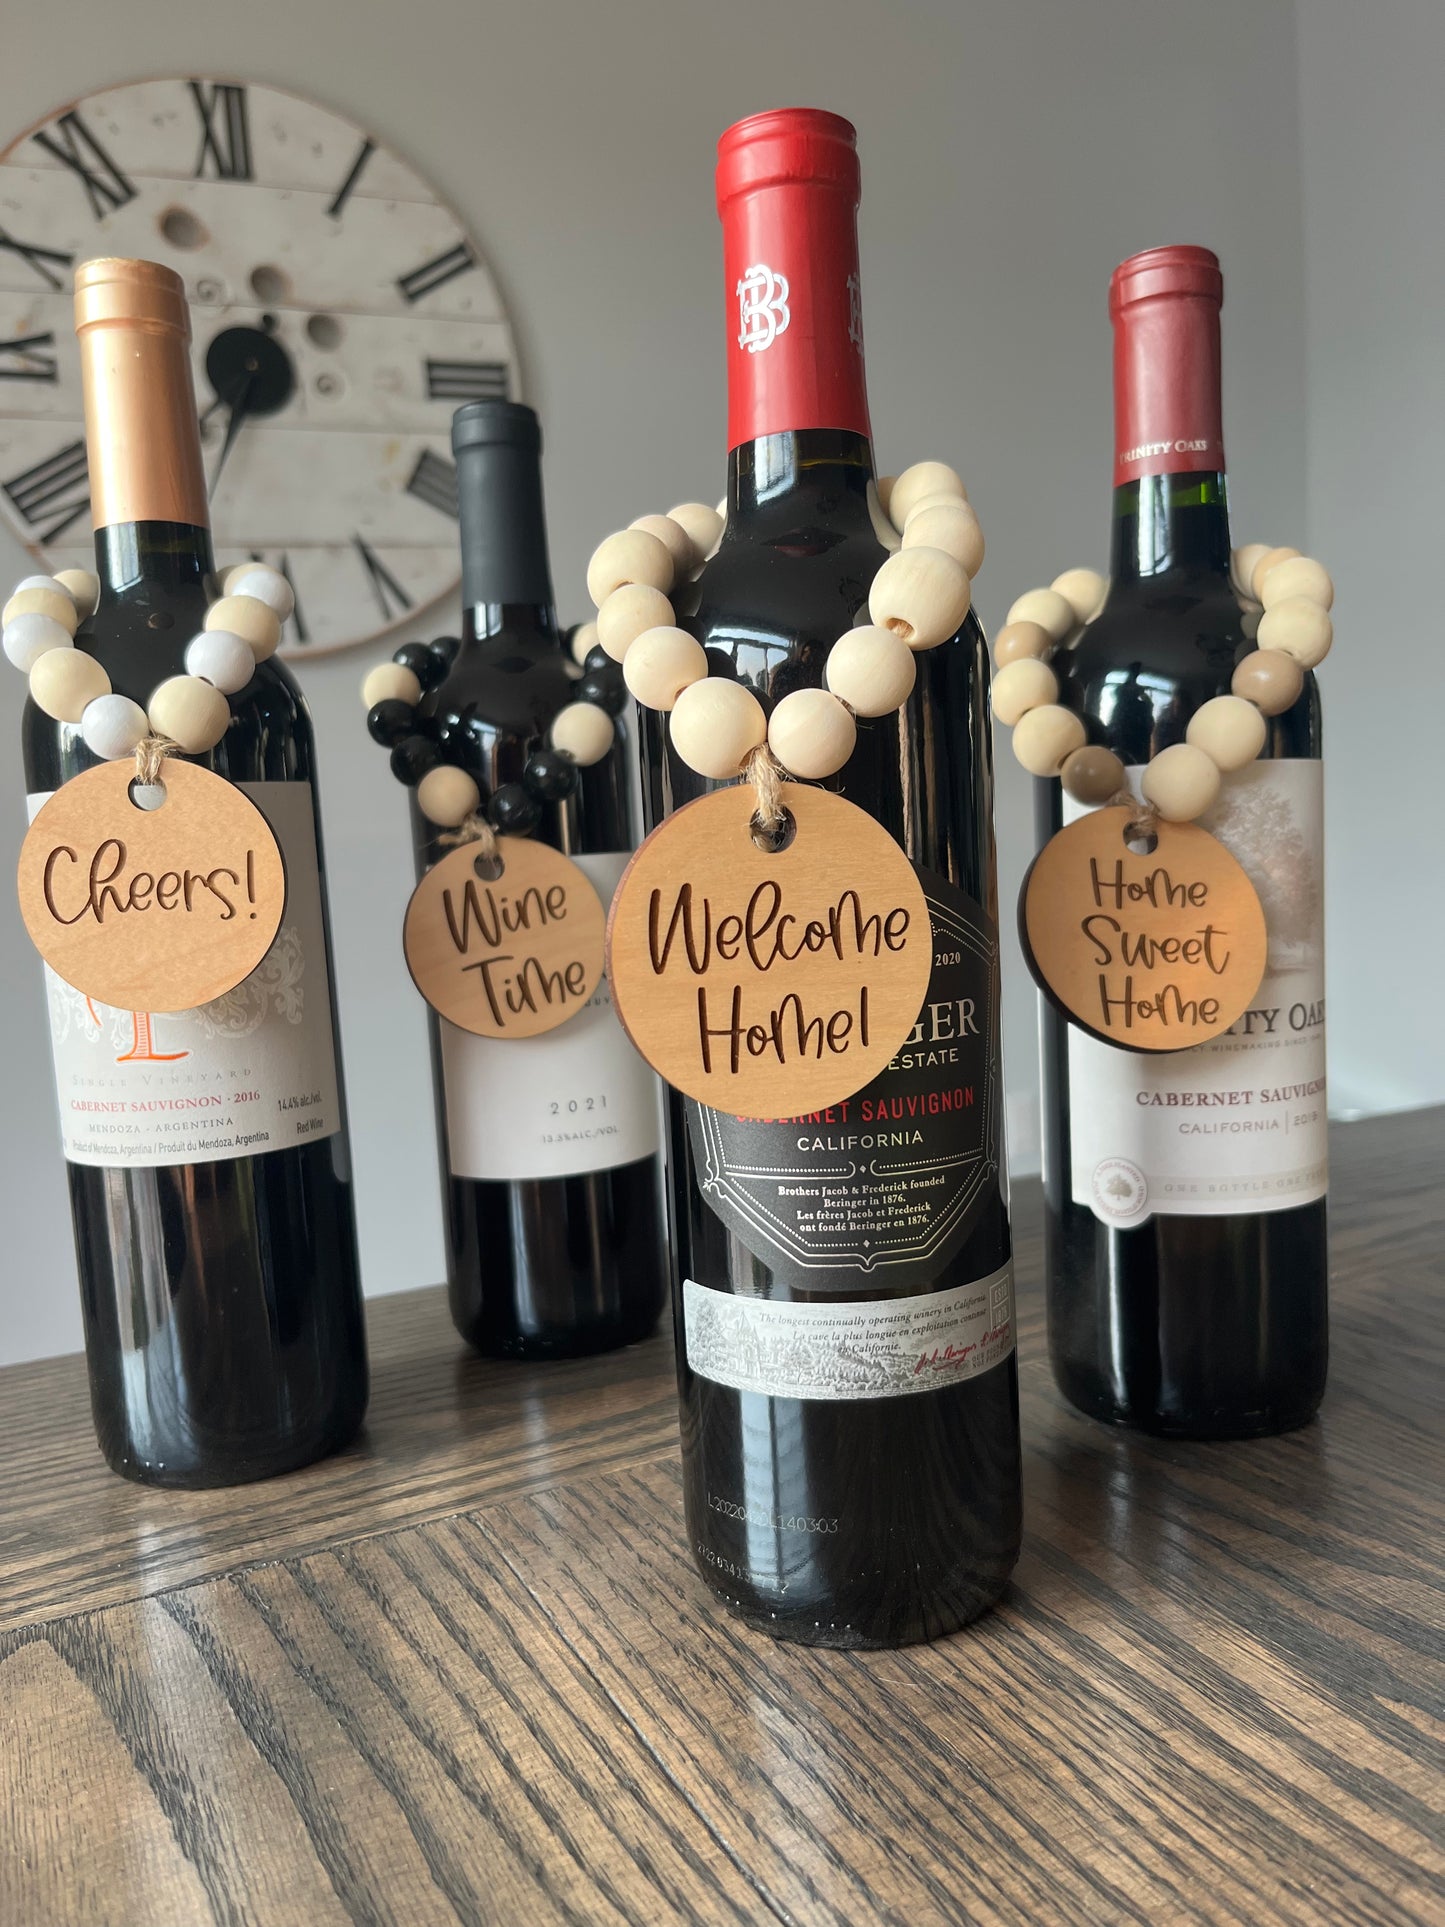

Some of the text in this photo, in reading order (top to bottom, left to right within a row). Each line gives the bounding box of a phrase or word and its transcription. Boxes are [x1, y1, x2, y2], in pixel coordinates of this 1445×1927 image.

[187, 79, 255, 181] XII
[43, 838, 257, 925] Cheers!
[1090, 857, 1208, 910] Home
[442, 879, 567, 954] Wine
[648, 880, 910, 975] Welcome
[1081, 914, 1230, 975] Sweet
[935, 951, 961, 967] 2020
[461, 955, 586, 1027] Time
[1099, 974, 1220, 1027] Home
[887, 1047, 959, 1070] ESTATE
[71, 1090, 260, 1113] CABERNET SAUVIGNON 2016
[550, 1095, 607, 1115] 2021
[861, 1086, 974, 1122] SAUVIGNON
[1135, 1091, 1254, 1107] CABERNET
[89, 1124, 141, 1134] MENDOZA
[155, 1117, 234, 1132] ARGENTINA
[1179, 1119, 1280, 1134] CALIFORNIA
[160, 1140, 185, 1153] Produit
[187, 1140, 197, 1151] du
[235, 1131, 270, 1147] Argentina
[797, 1129, 924, 1151] CALIFORNIA
[778, 1175, 945, 1197] Brothers Jacob & Frederick founded
[796, 1202, 931, 1220] Les frères Jacob et Frederick
[823, 1194, 906, 1209] Beringer in 1876.
[799, 1214, 930, 1232] ont fondé Beringer en 1876.
[779, 1315, 810, 1327] longest
[812, 1316, 866, 1327] continually
[868, 1312, 911, 1327] operating
[914, 1309, 941, 1320] winery
[943, 1304, 952, 1313] in
[831, 1332, 840, 1341] la
[843, 1331, 863, 1342] plus
[865, 1328, 896, 1342] longue
[899, 1329, 909, 1337] en
